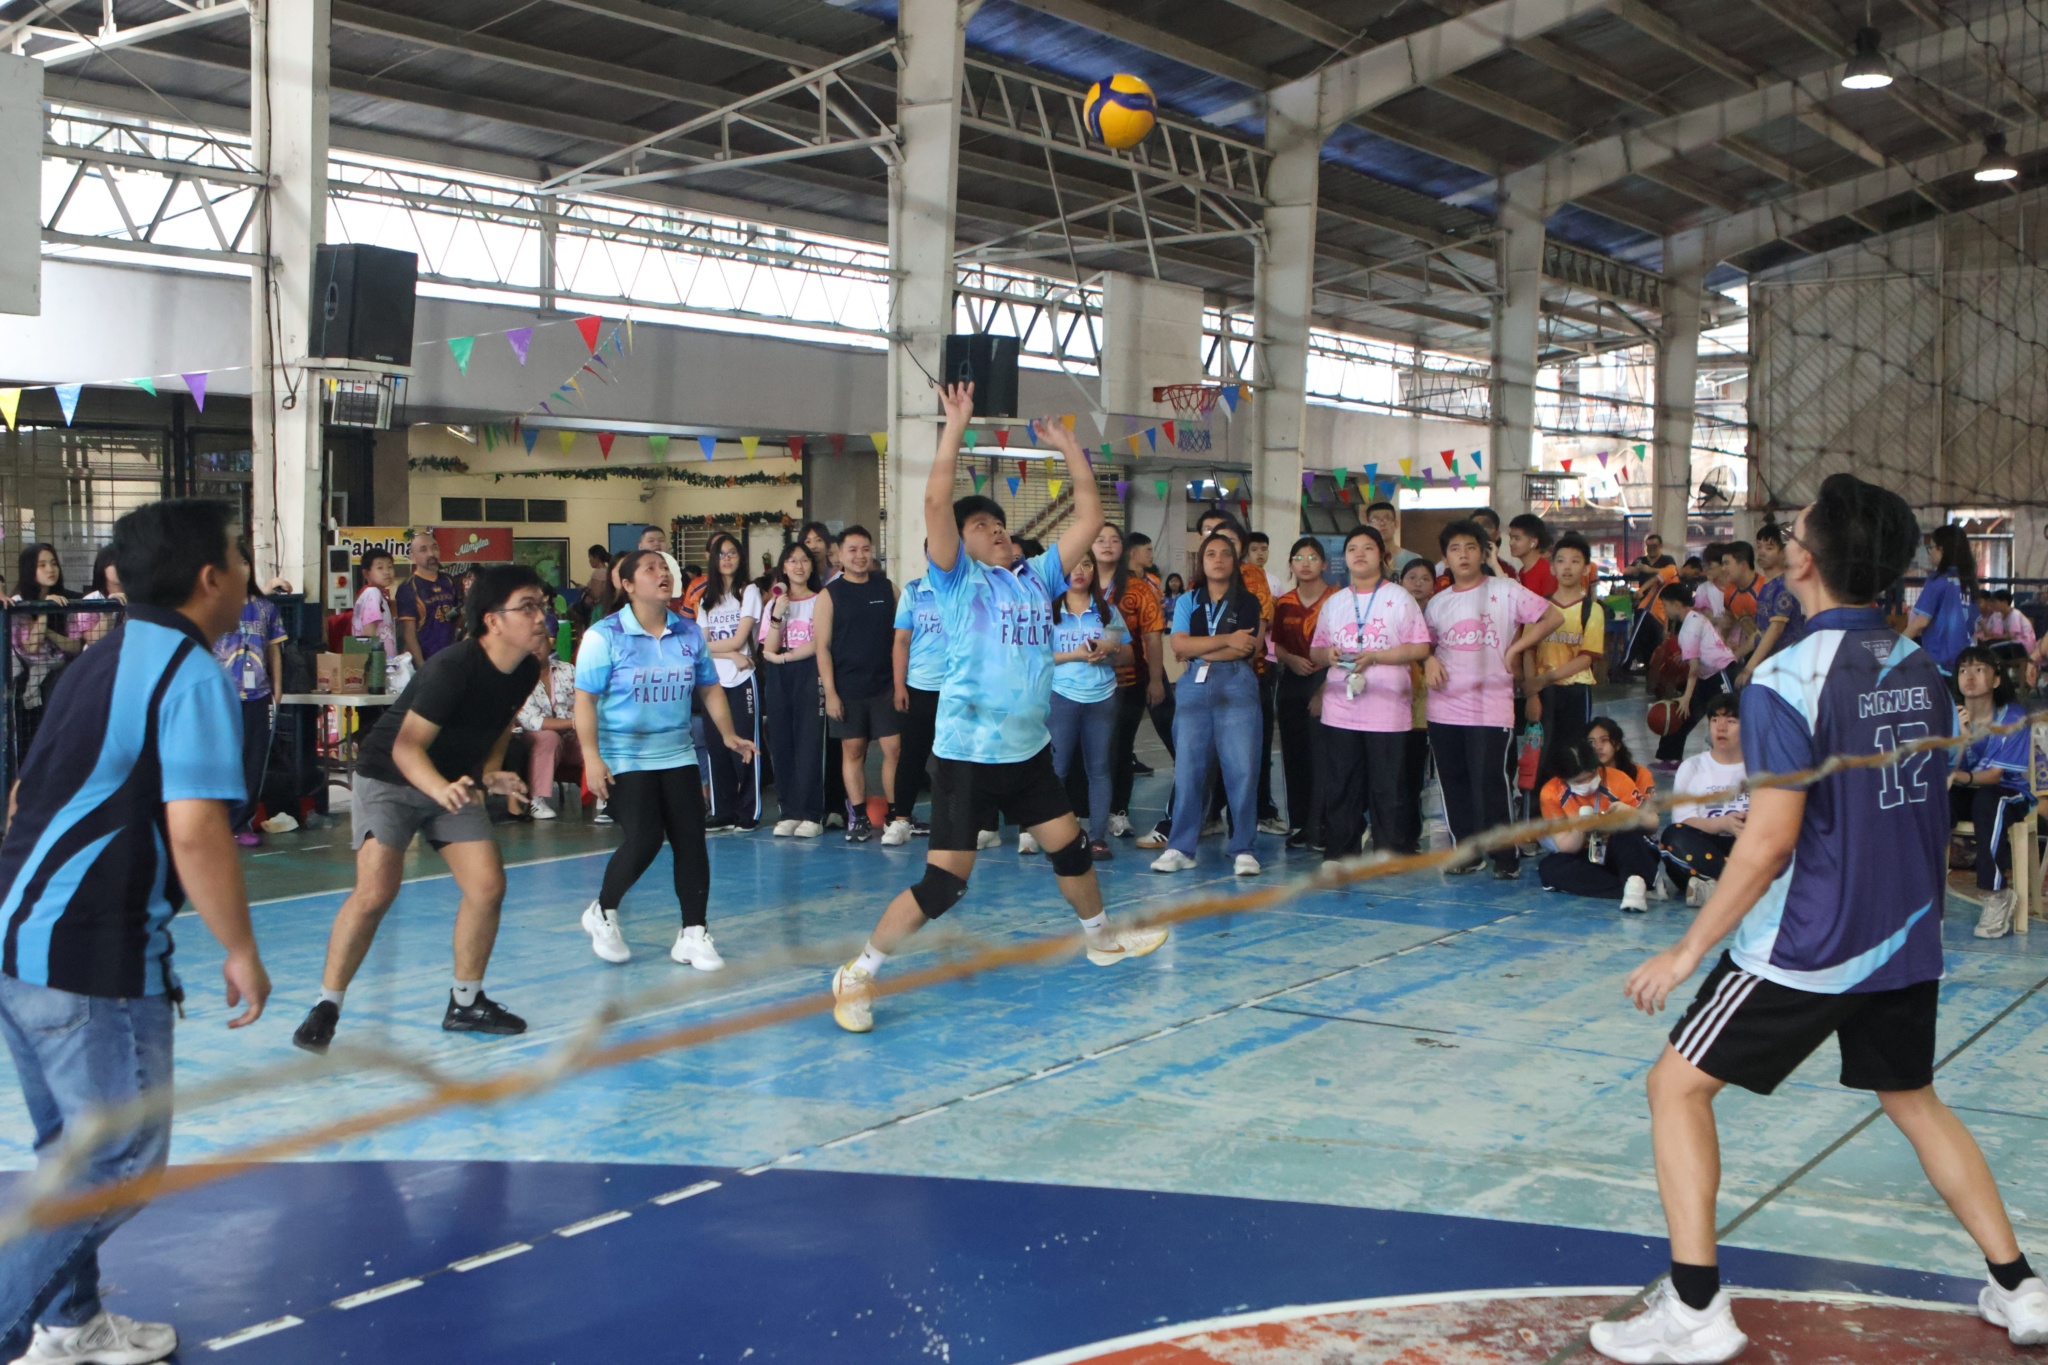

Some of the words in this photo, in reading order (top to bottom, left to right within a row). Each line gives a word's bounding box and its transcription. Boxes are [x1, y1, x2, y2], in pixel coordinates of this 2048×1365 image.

[632, 667, 693, 685] HCHS
[1859, 687, 1932, 718] MANUEL
[1874, 721, 1932, 809] 12
